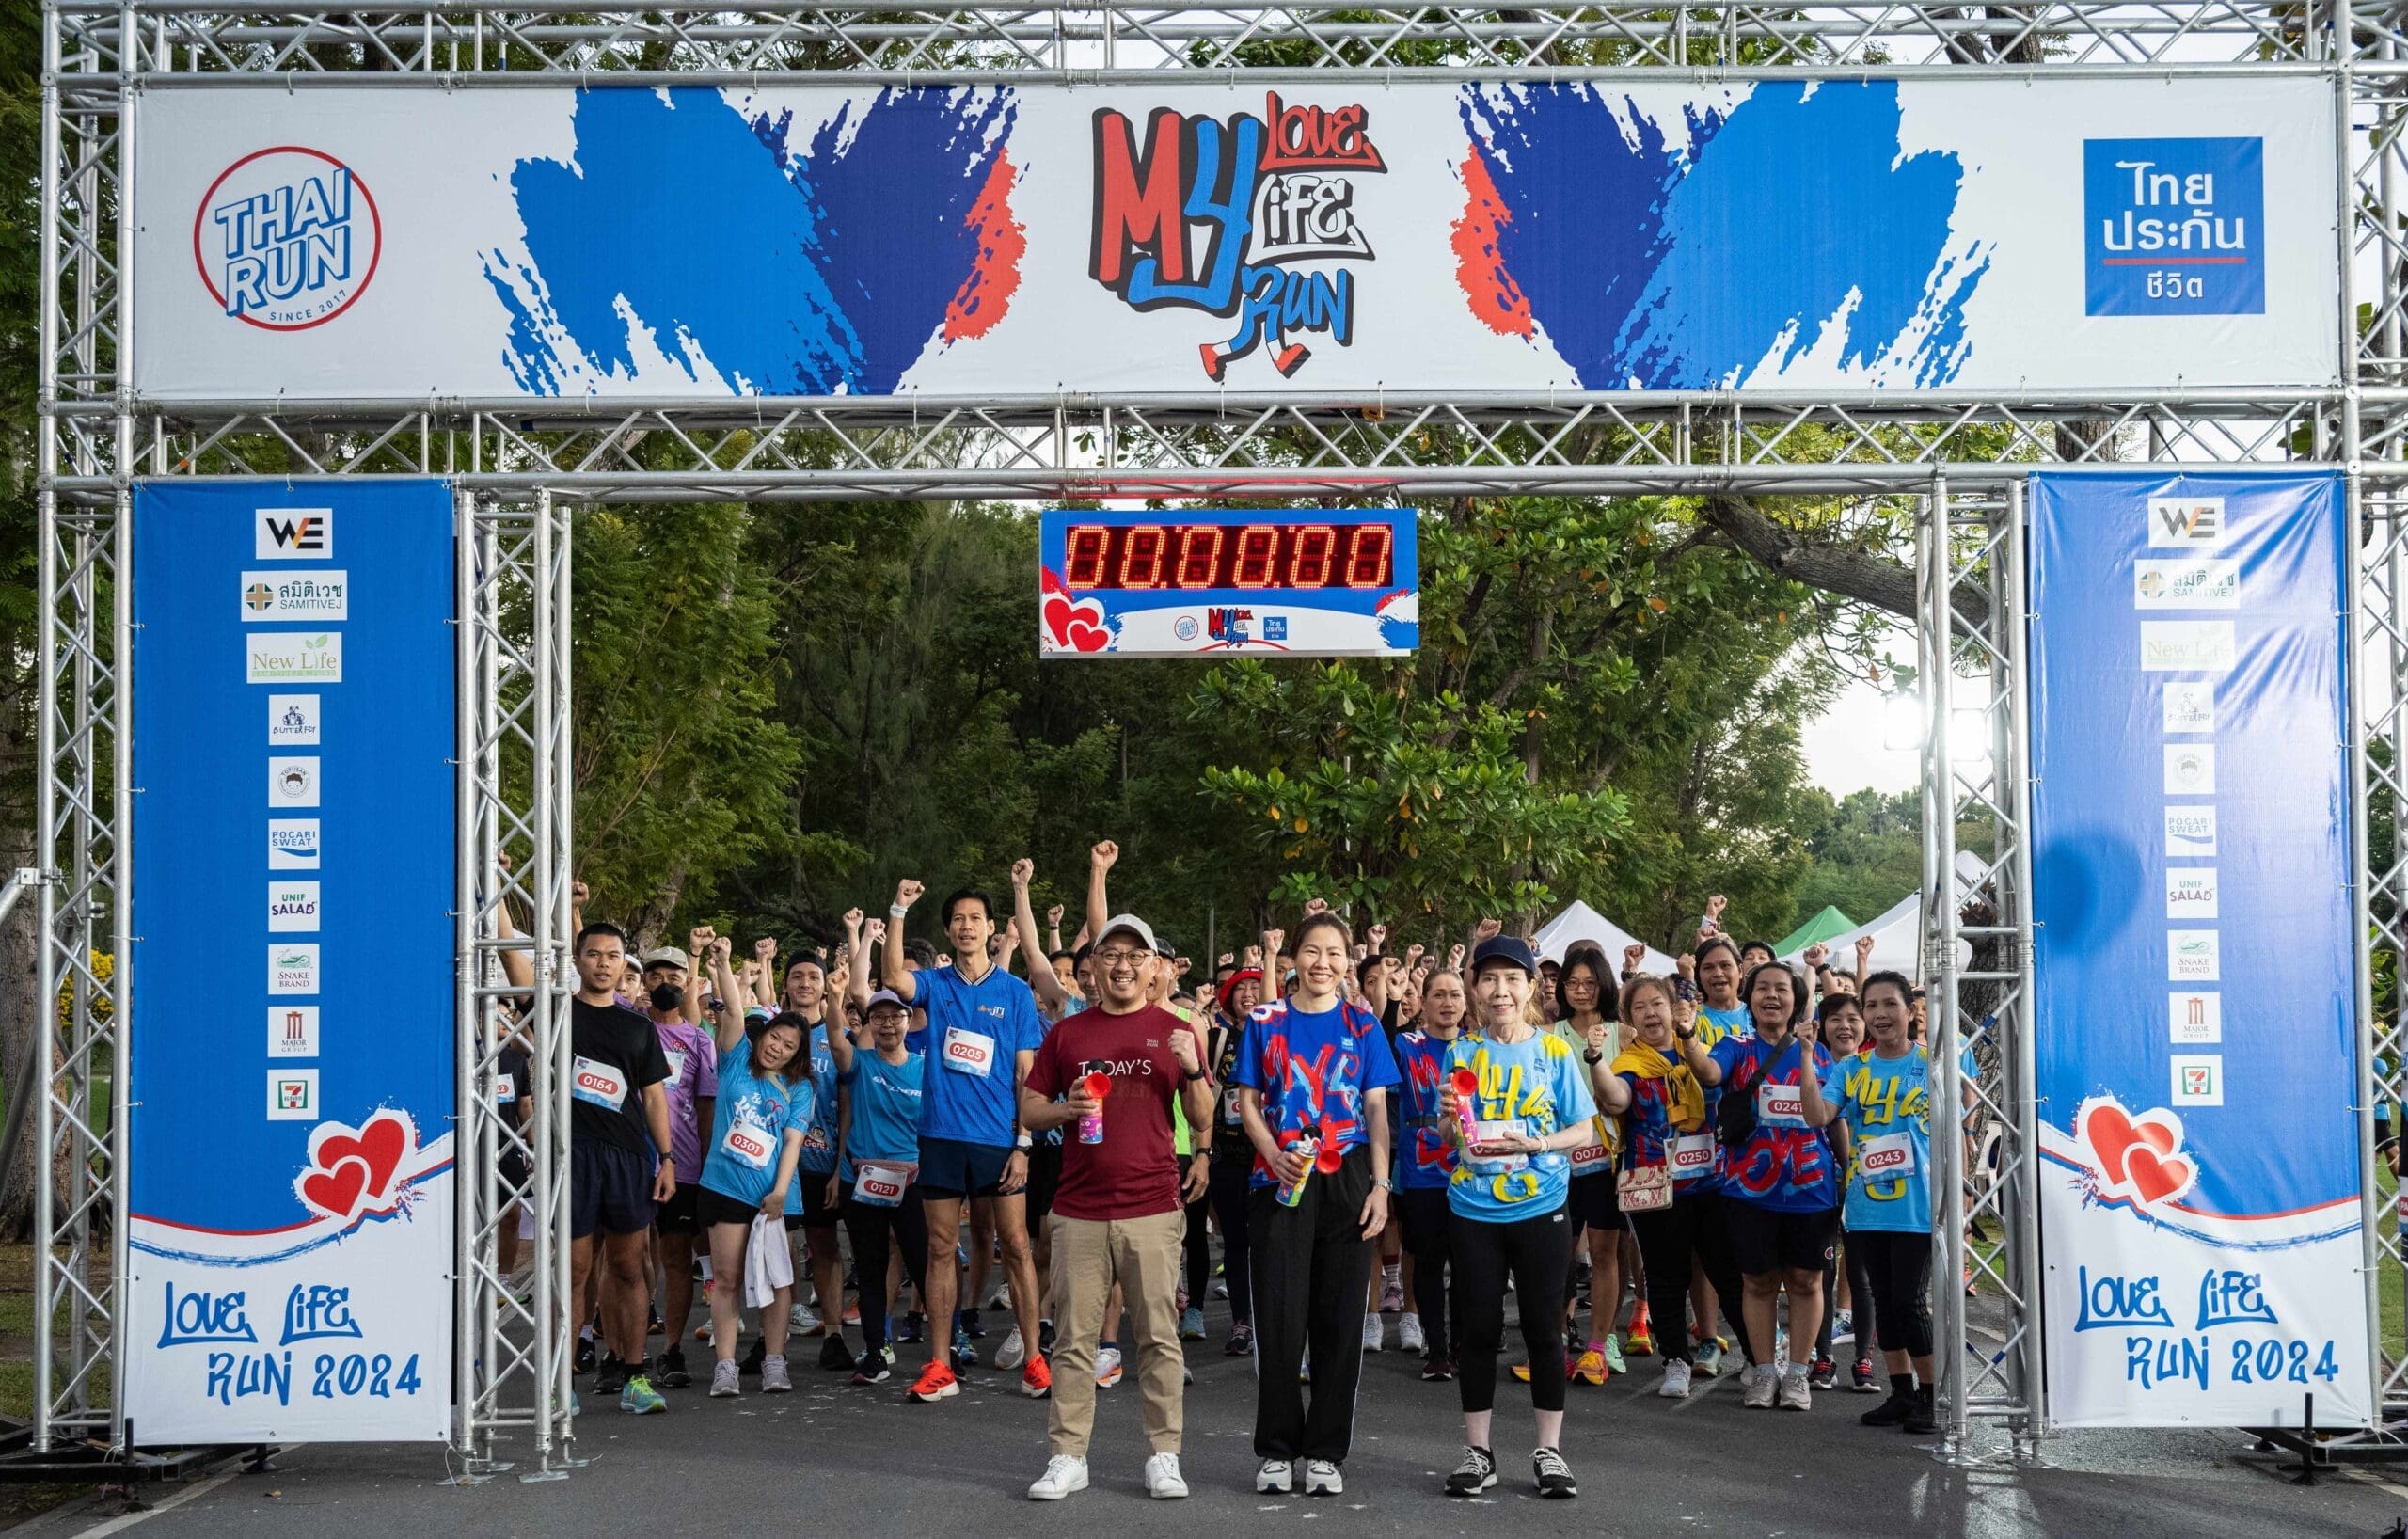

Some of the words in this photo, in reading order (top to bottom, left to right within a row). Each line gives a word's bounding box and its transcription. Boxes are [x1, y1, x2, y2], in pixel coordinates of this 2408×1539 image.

[1259, 90, 1387, 173] LOVE
[2115, 160, 2213, 206] ไทย
[215, 167, 351, 260] THAI
[2103, 209, 2246, 251] ประกัน
[226, 225, 351, 317] RUN
[2147, 270, 2204, 299] ชีวิต
[270, 308, 313, 323] SINCE
[319, 288, 348, 313] 2017
[1199, 264, 1354, 382] RUN
[2159, 507, 2215, 538] WE
[266, 518, 323, 549] WE
[279, 581, 342, 598] สมิติเวช
[280, 599, 341, 610] SAMITIVEJ
[252, 653, 294, 670] New
[2168, 817, 2212, 826] POCARI
[2168, 825, 2209, 833] SWEAT
[272, 831, 316, 839] POCARI
[272, 838, 312, 847] SWEAT
[2179, 880, 2203, 888] UNIF
[281, 893, 306, 901] UNIF
[2169, 888, 2213, 902] SALAD
[272, 902, 317, 915] SALAD
[2178, 958, 2210, 966] SNAKE
[278, 971, 309, 979] SNAKE
[952, 1044, 984, 1061] 0205
[1078, 1059, 1152, 1076] TDAY'S
[583, 1075, 613, 1092] 0164
[734, 1135, 761, 1155] 0301
[1575, 1146, 1605, 1161] 0077
[1679, 1150, 1710, 1164] 0250
[1868, 1150, 1902, 1166] 0243
[870, 1182, 895, 1195] 0121
[2074, 1265, 2174, 1332] LOVE
[156, 1281, 259, 1349] LOVE
[2126, 1335, 2209, 1390] RUN
[2231, 1340, 2339, 1384] 2024
[207, 1351, 292, 1406] RUN
[313, 1353, 421, 1398] 2024
